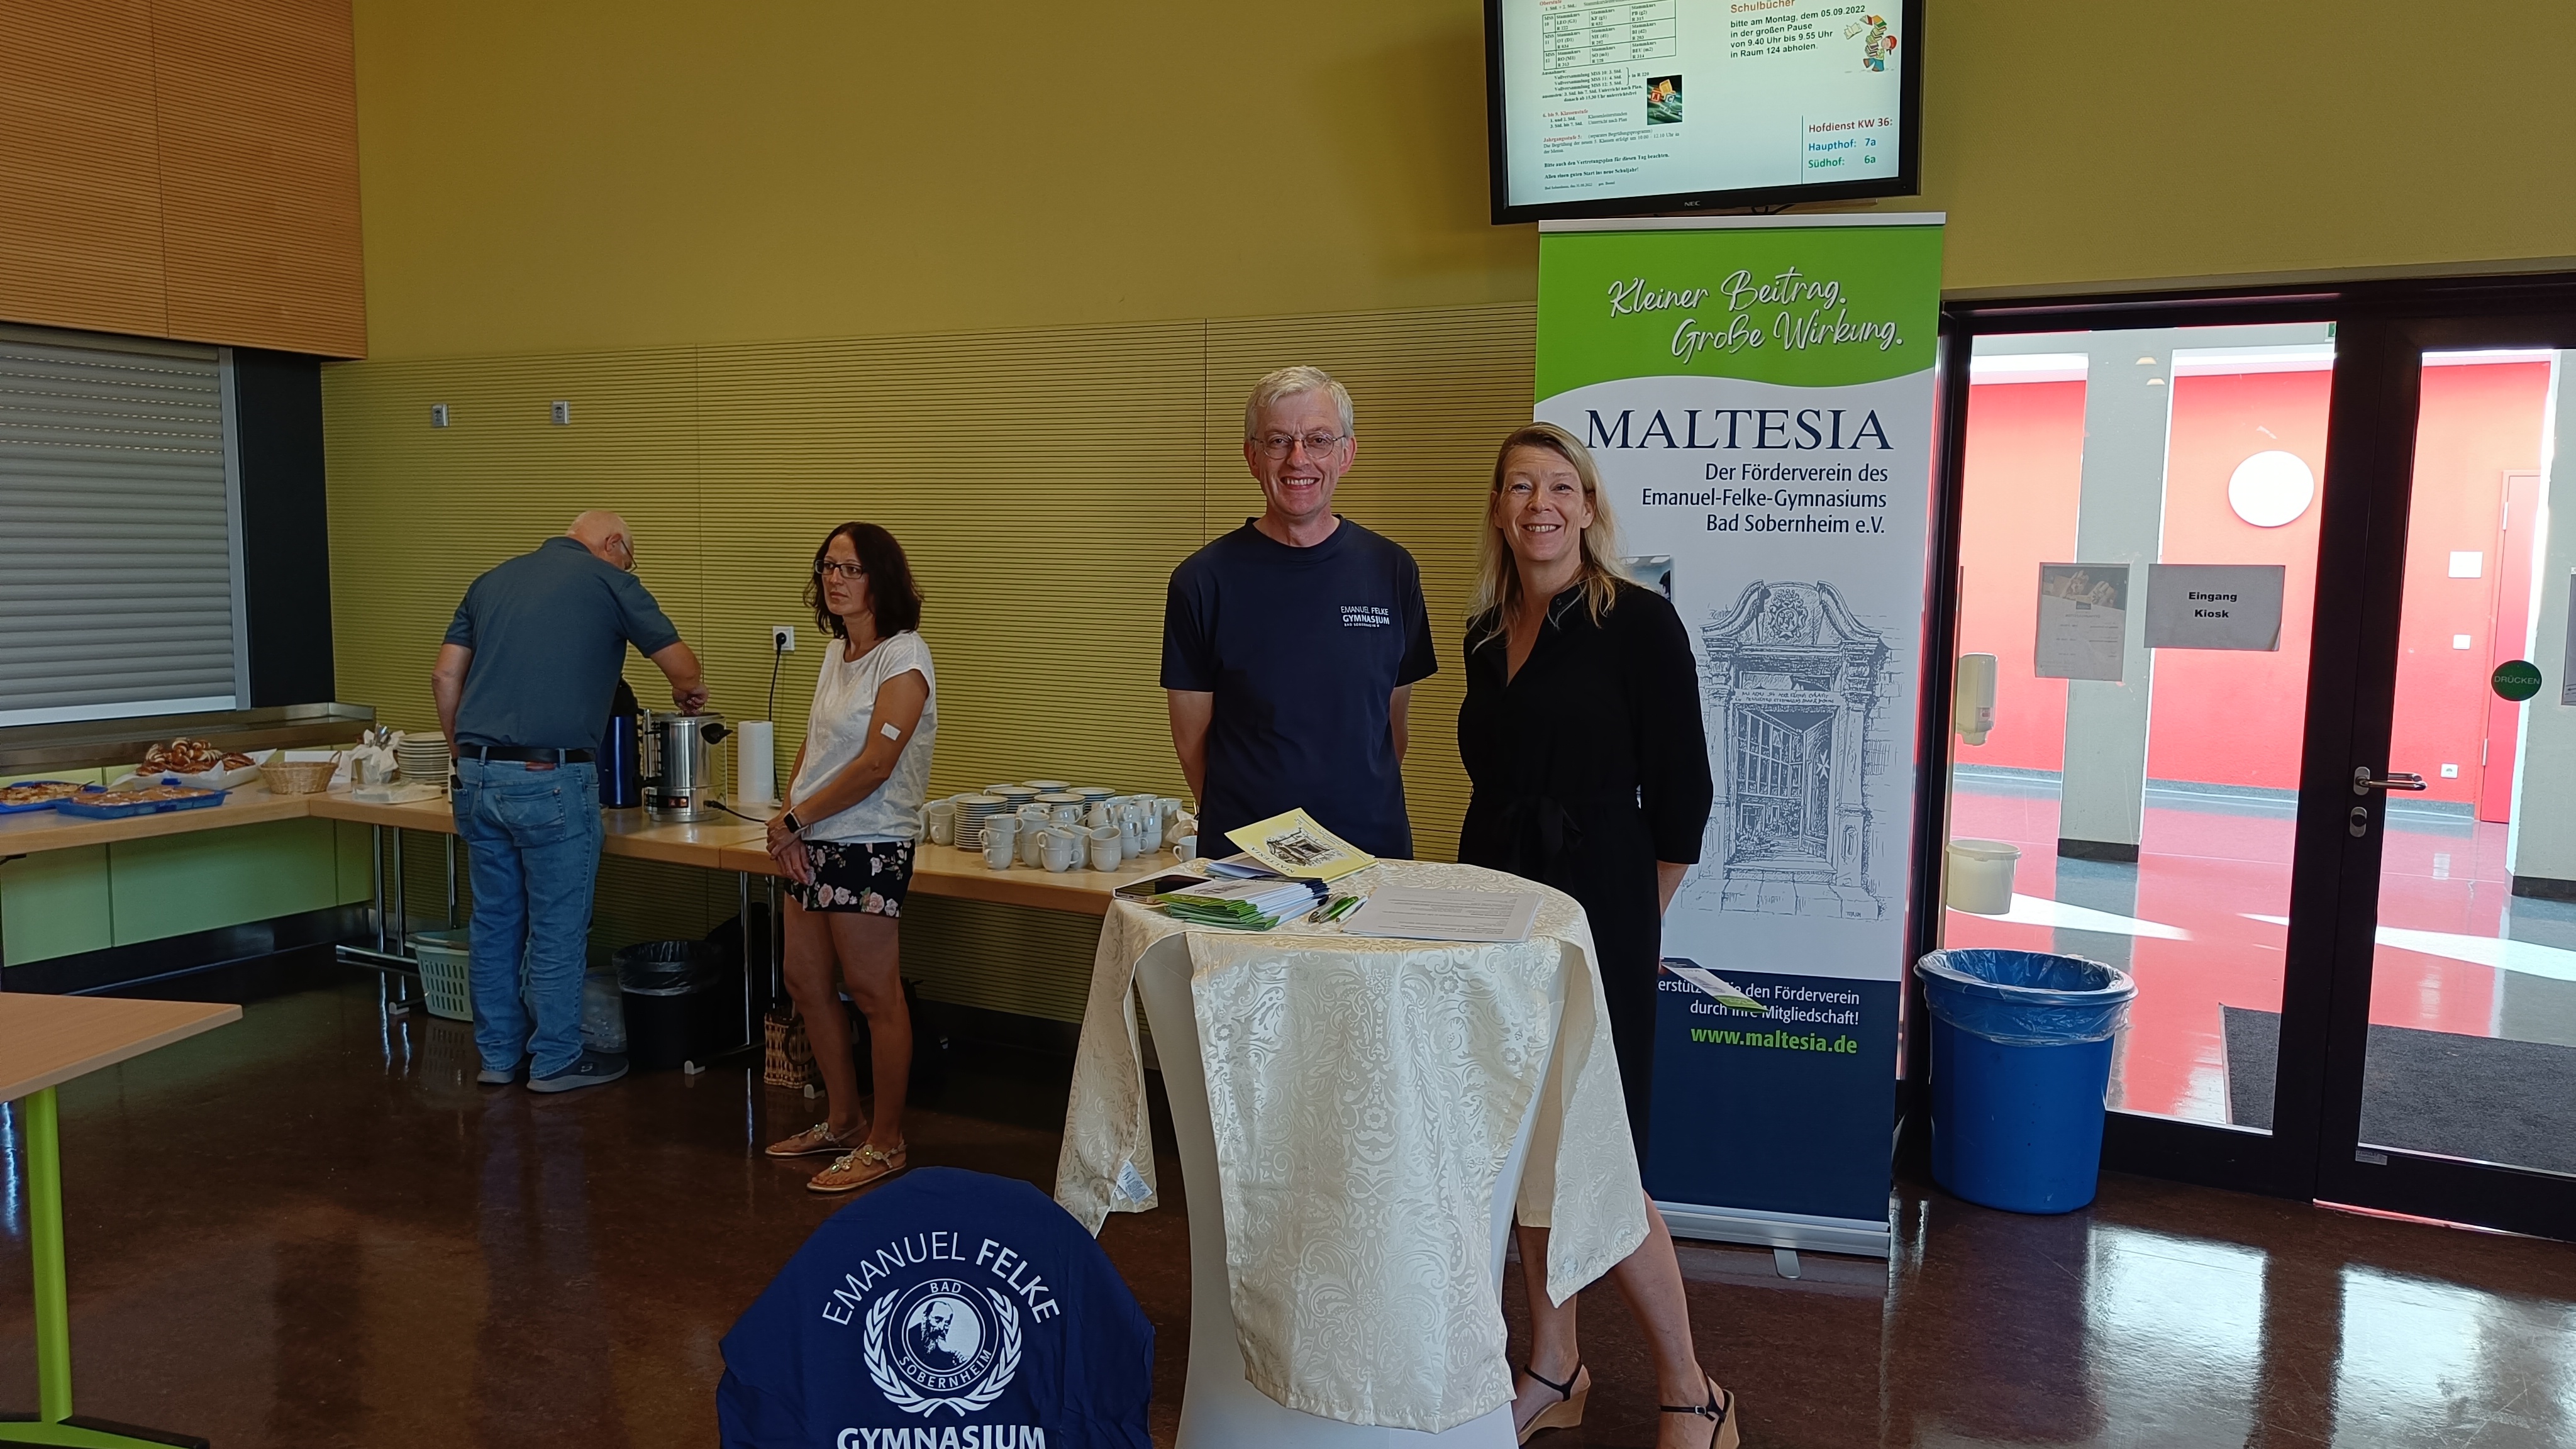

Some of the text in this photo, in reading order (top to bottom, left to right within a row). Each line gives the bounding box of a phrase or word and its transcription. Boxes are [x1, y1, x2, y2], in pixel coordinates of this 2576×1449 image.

[1731, 0, 1795, 13] Schulbücher
[1766, 15, 1798, 24] Montag,
[1821, 5, 1865, 17] 05.09.2022
[1741, 29, 1752, 37] der
[1756, 26, 1784, 36] großen
[1784, 34, 1796, 42] bis
[1818, 30, 1833, 38] Uhr
[1741, 49, 1763, 57] Raum
[1783, 43, 1818, 52] abholen.
[1809, 118, 1892, 133] Hofdienst KW 36:
[1809, 138, 1876, 152] Haupthof: 7a
[1808, 155, 1876, 169] Südhof: 6a
[1607, 265, 1846, 318] Kleiner Beitrag.
[1671, 308, 1903, 364] Große Wirkung.
[1585, 409, 1894, 450] MALTESIA
[1706, 463, 1888, 482] Der Förderverein des
[1642, 488, 1887, 511] Emanuel-Felke-Gymnasiums
[1706, 513, 1885, 533] Bad Sobernheim e.V.
[2189, 591, 2238, 602] Eingang
[1343, 614, 1390, 625] GYMNASIUM
[1371, 607, 1389, 615] FELKE
[2194, 609, 2229, 618] Kiosk
[2494, 675, 2540, 684] DRÜCKEN
[1745, 983, 1770, 999] den
[1775, 985, 1860, 1005] Förderverein
[1690, 999, 1727, 1016] durch
[1762, 1005, 1859, 1026] Mitgliedschaft!
[1690, 1028, 1858, 1054] www.maltesia.de
[822, 1231, 1060, 1326] EMANUEL FELKE
[929, 1282, 962, 1294] BAD
[898, 1348, 992, 1389] SOBERNHEIM
[836, 1425, 1046, 1449] GYMNASIUM
